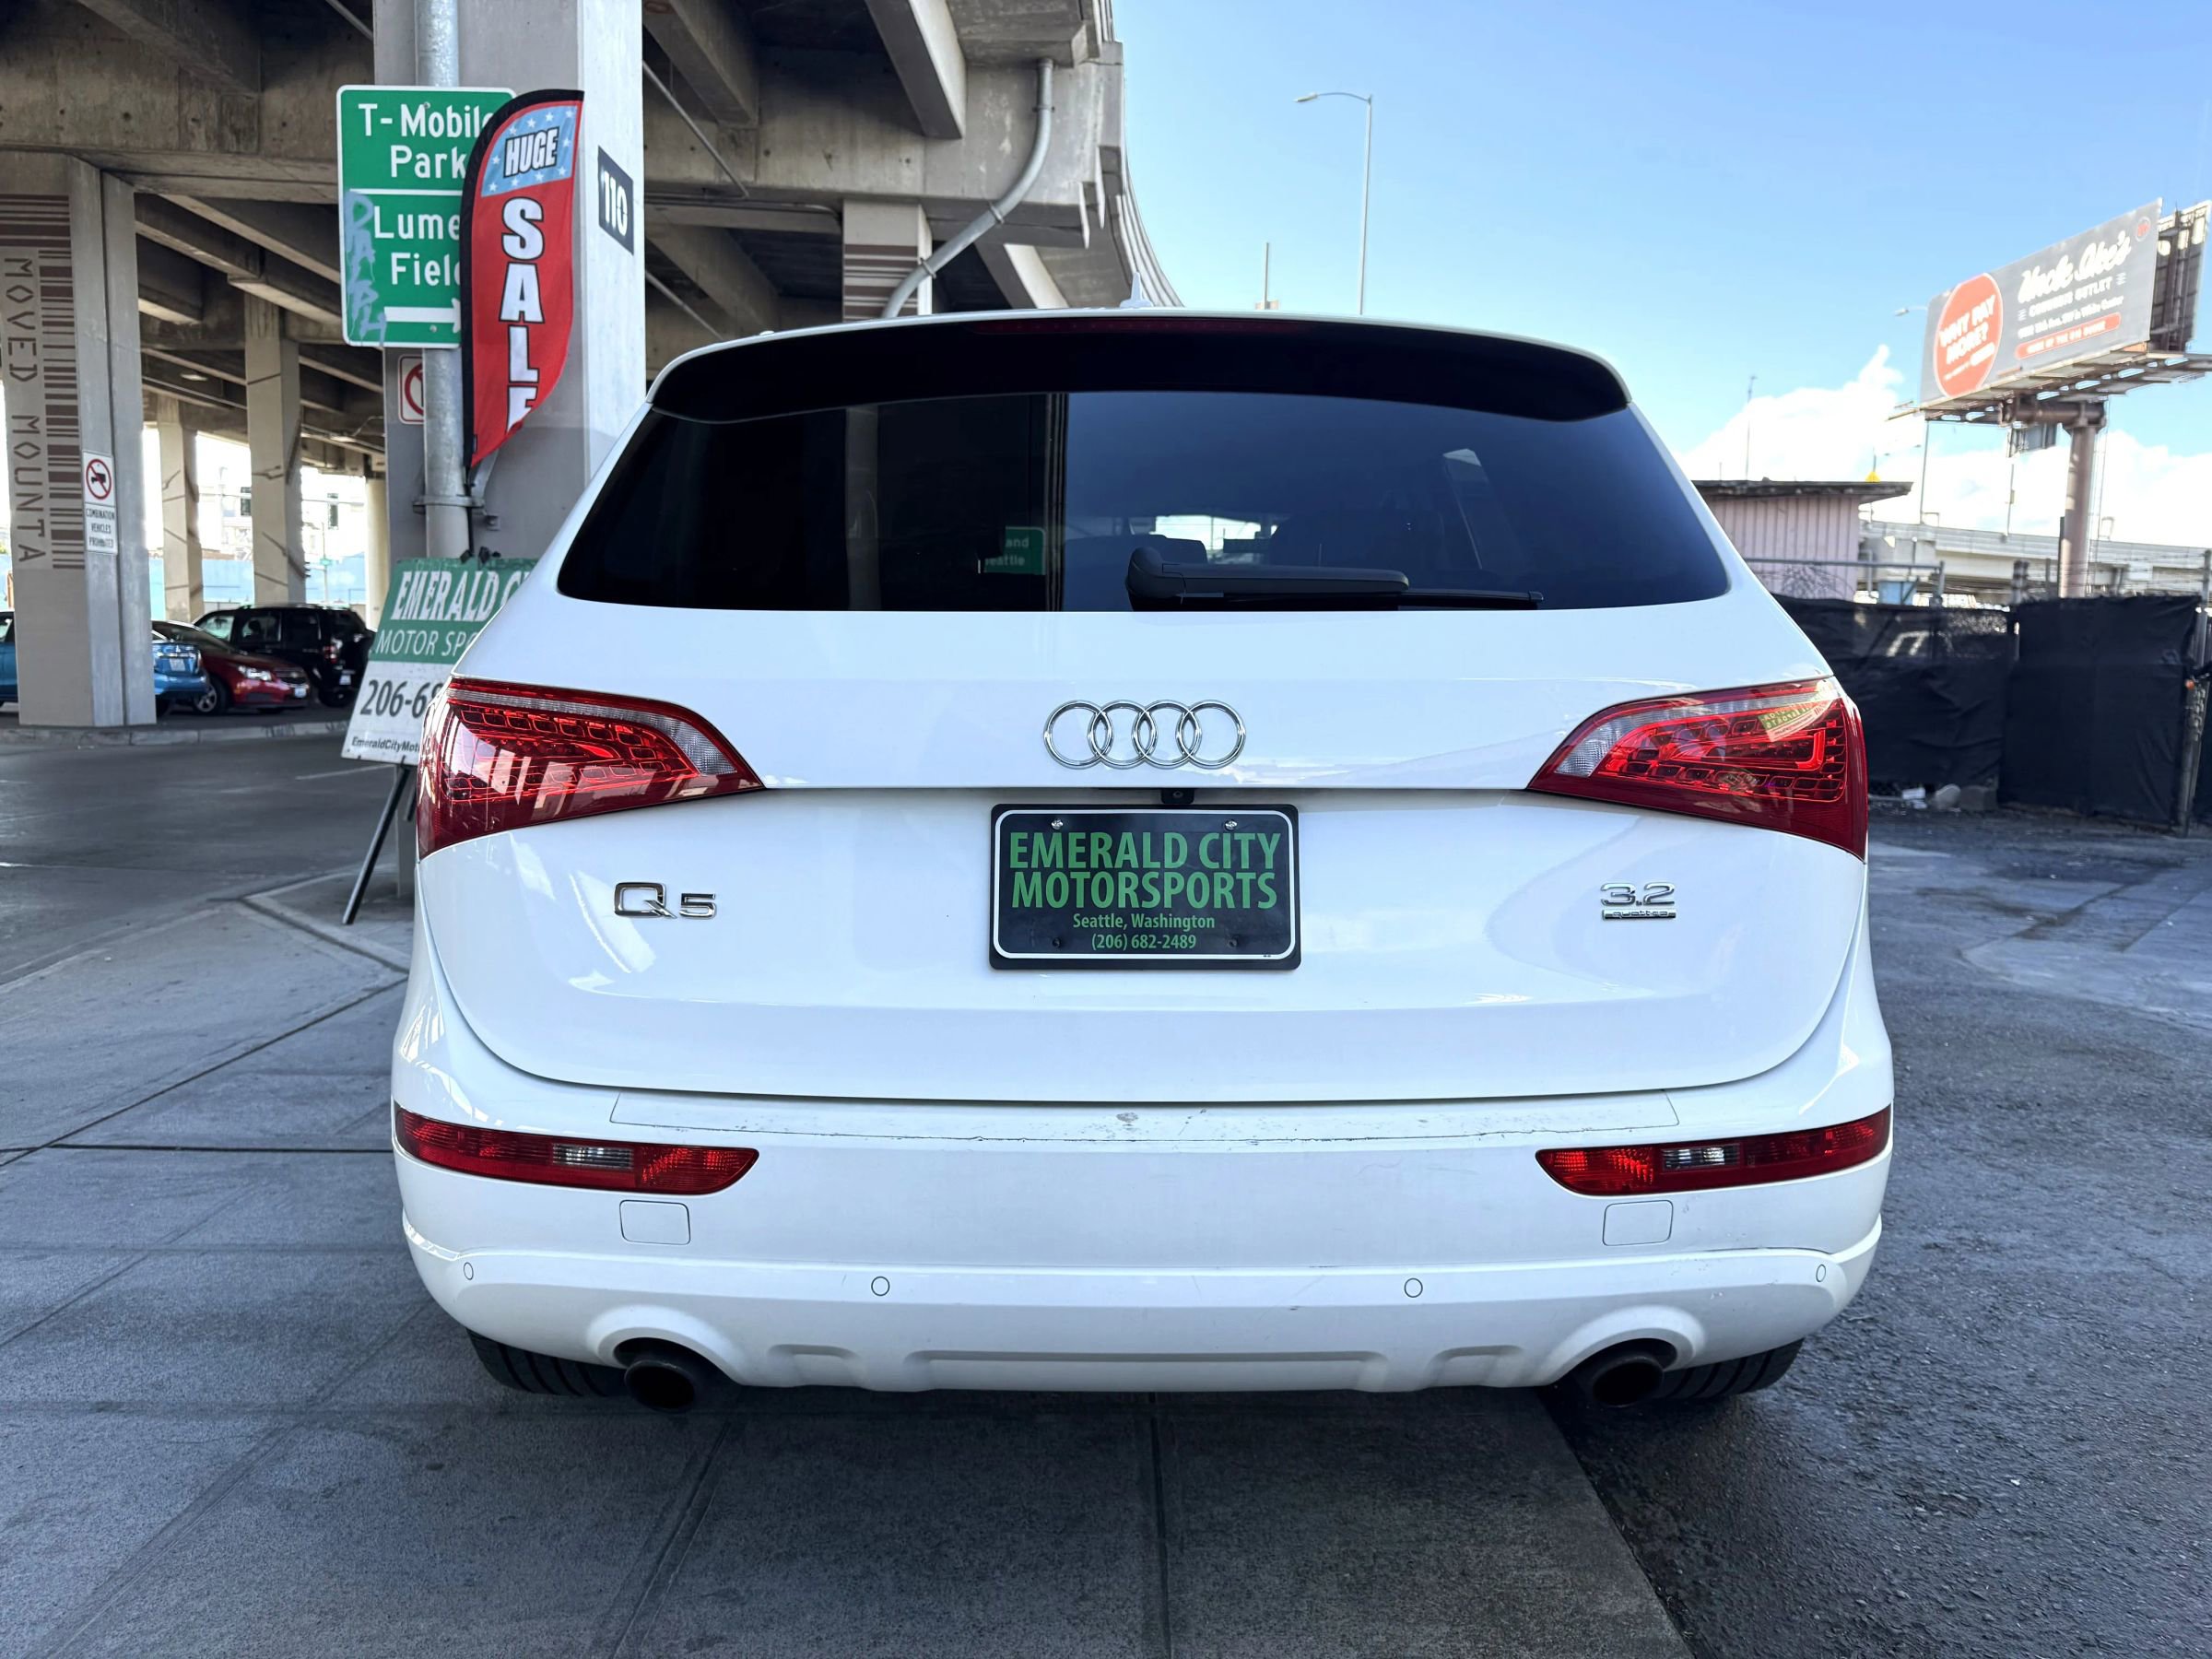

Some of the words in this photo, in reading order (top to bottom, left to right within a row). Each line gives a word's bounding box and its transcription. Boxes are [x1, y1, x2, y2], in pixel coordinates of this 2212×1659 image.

[390, 147, 466, 180] Park
[503, 125, 559, 178] HUGE
[601, 170, 629, 237] 110
[5, 258, 38, 382] MOVED
[11, 415, 46, 562] MOUNTA
[390, 571, 500, 622] EMERALD
[377, 629, 440, 655] MOTOR
[351, 735, 420, 752] EmeraldCityMot
[1009, 832, 1188, 869] EMERALD
[1199, 832, 1281, 869] CITY
[1012, 871, 1277, 909] MOTORSPORTS
[1600, 882, 1676, 906] 3.2
[1073, 912, 1127, 931] Seattle,
[1131, 912, 1215, 933] Washington
[1091, 934, 1128, 950] (206)
[1131, 935, 1196, 949] 682-2489
